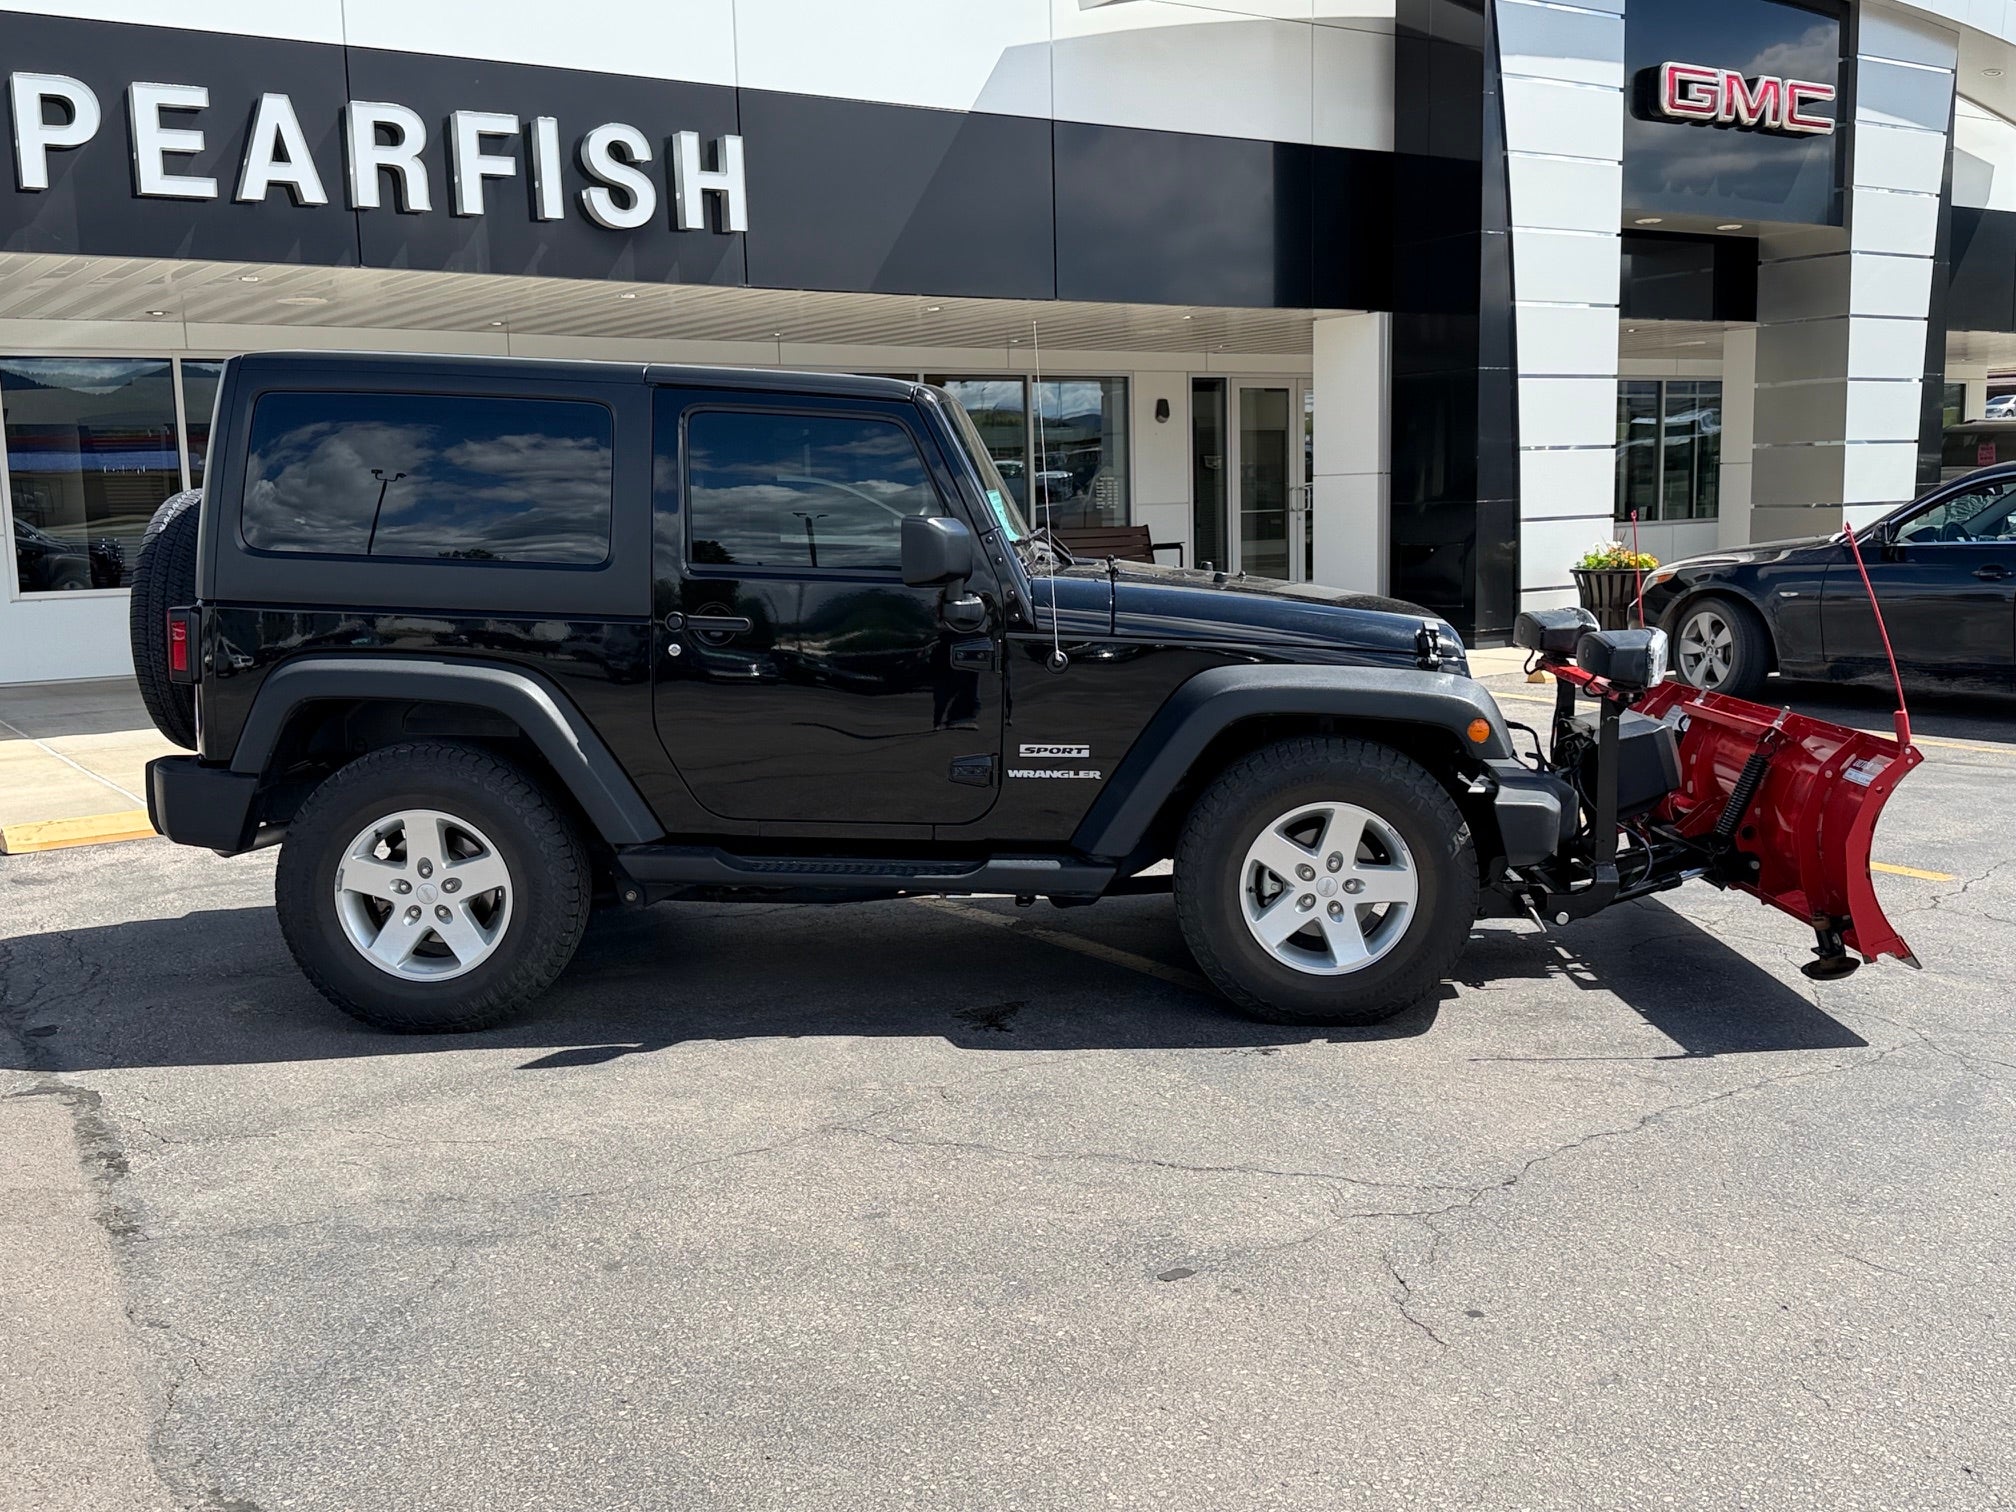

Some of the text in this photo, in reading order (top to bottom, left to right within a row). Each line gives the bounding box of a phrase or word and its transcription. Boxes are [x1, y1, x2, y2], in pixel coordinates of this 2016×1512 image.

[1660, 61, 1836, 135] GMC
[9, 71, 748, 232] PEARFISH
[1022, 746, 1089, 756] SPORT
[1007, 769, 1102, 780] WRANGLER
